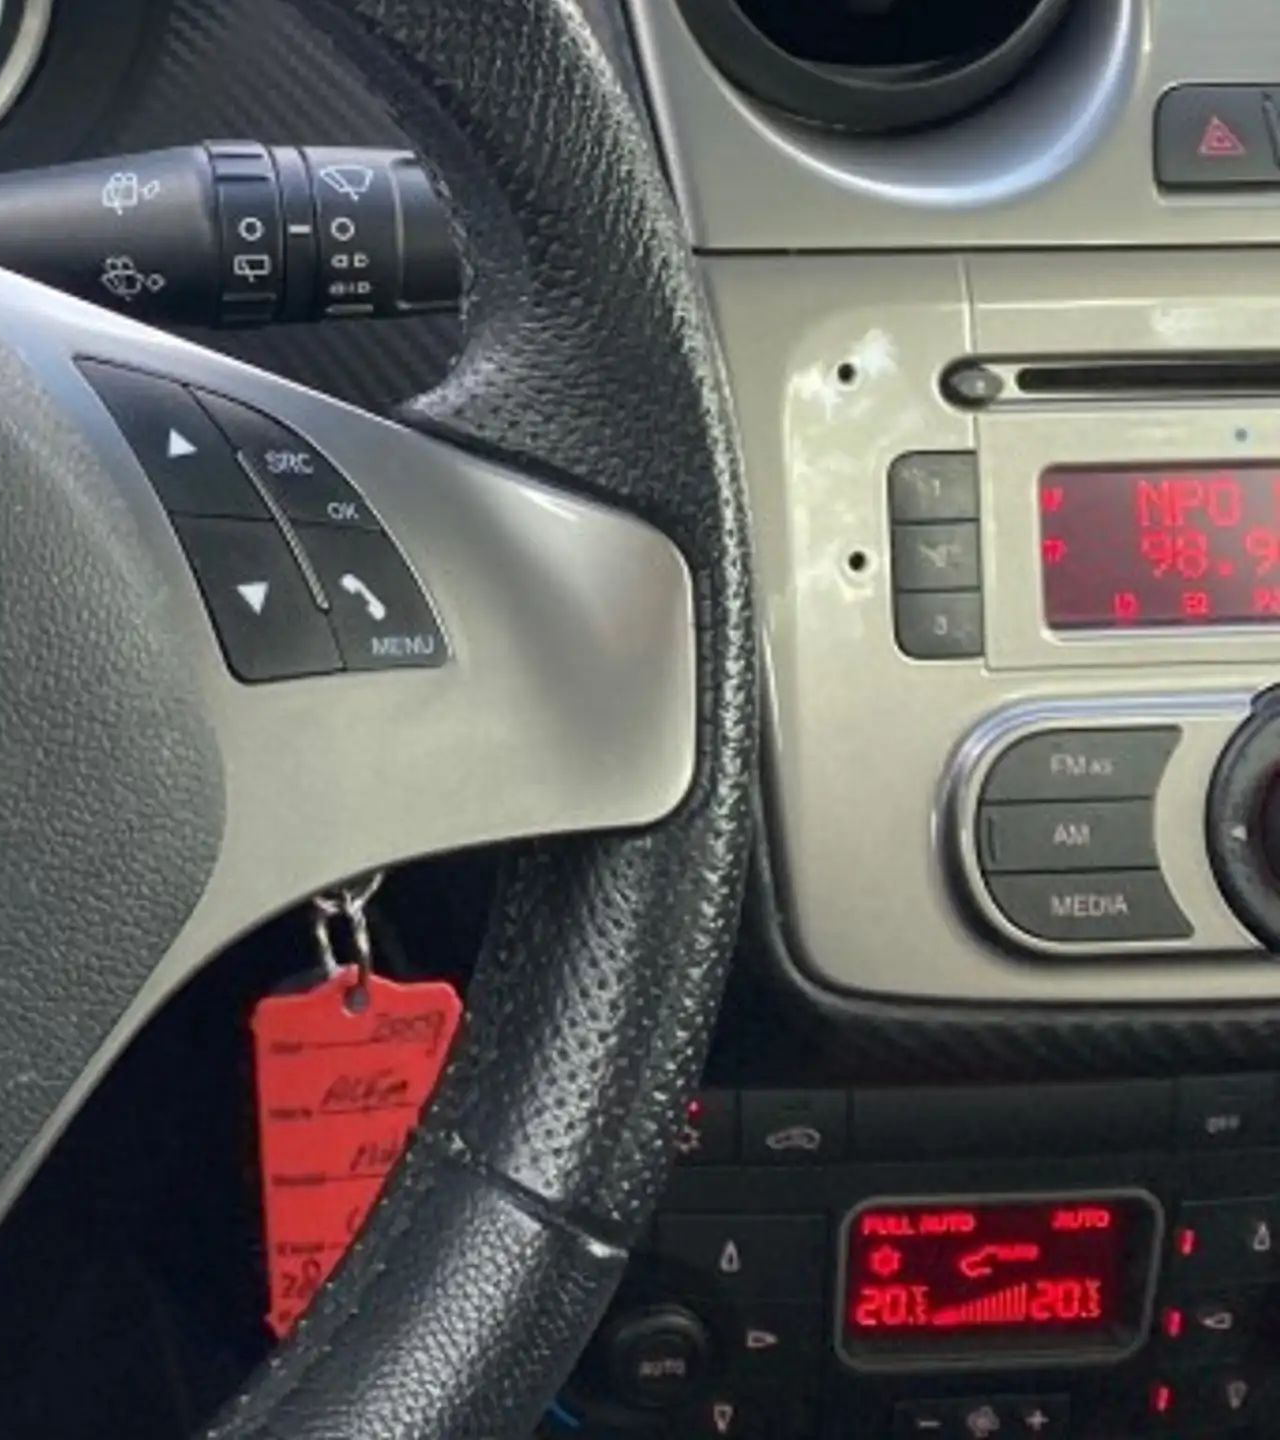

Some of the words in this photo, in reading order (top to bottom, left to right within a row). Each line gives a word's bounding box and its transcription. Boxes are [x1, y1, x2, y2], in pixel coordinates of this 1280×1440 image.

[263, 450, 315, 475] SRC
[325, 501, 360, 522] OK
[1137, 478, 1243, 527] NPO
[371, 635, 435, 657] MENU
[1052, 822, 1092, 848] AM
[1050, 892, 1130, 918] MEDIA
[1051, 1208, 1110, 1230] AUTO
